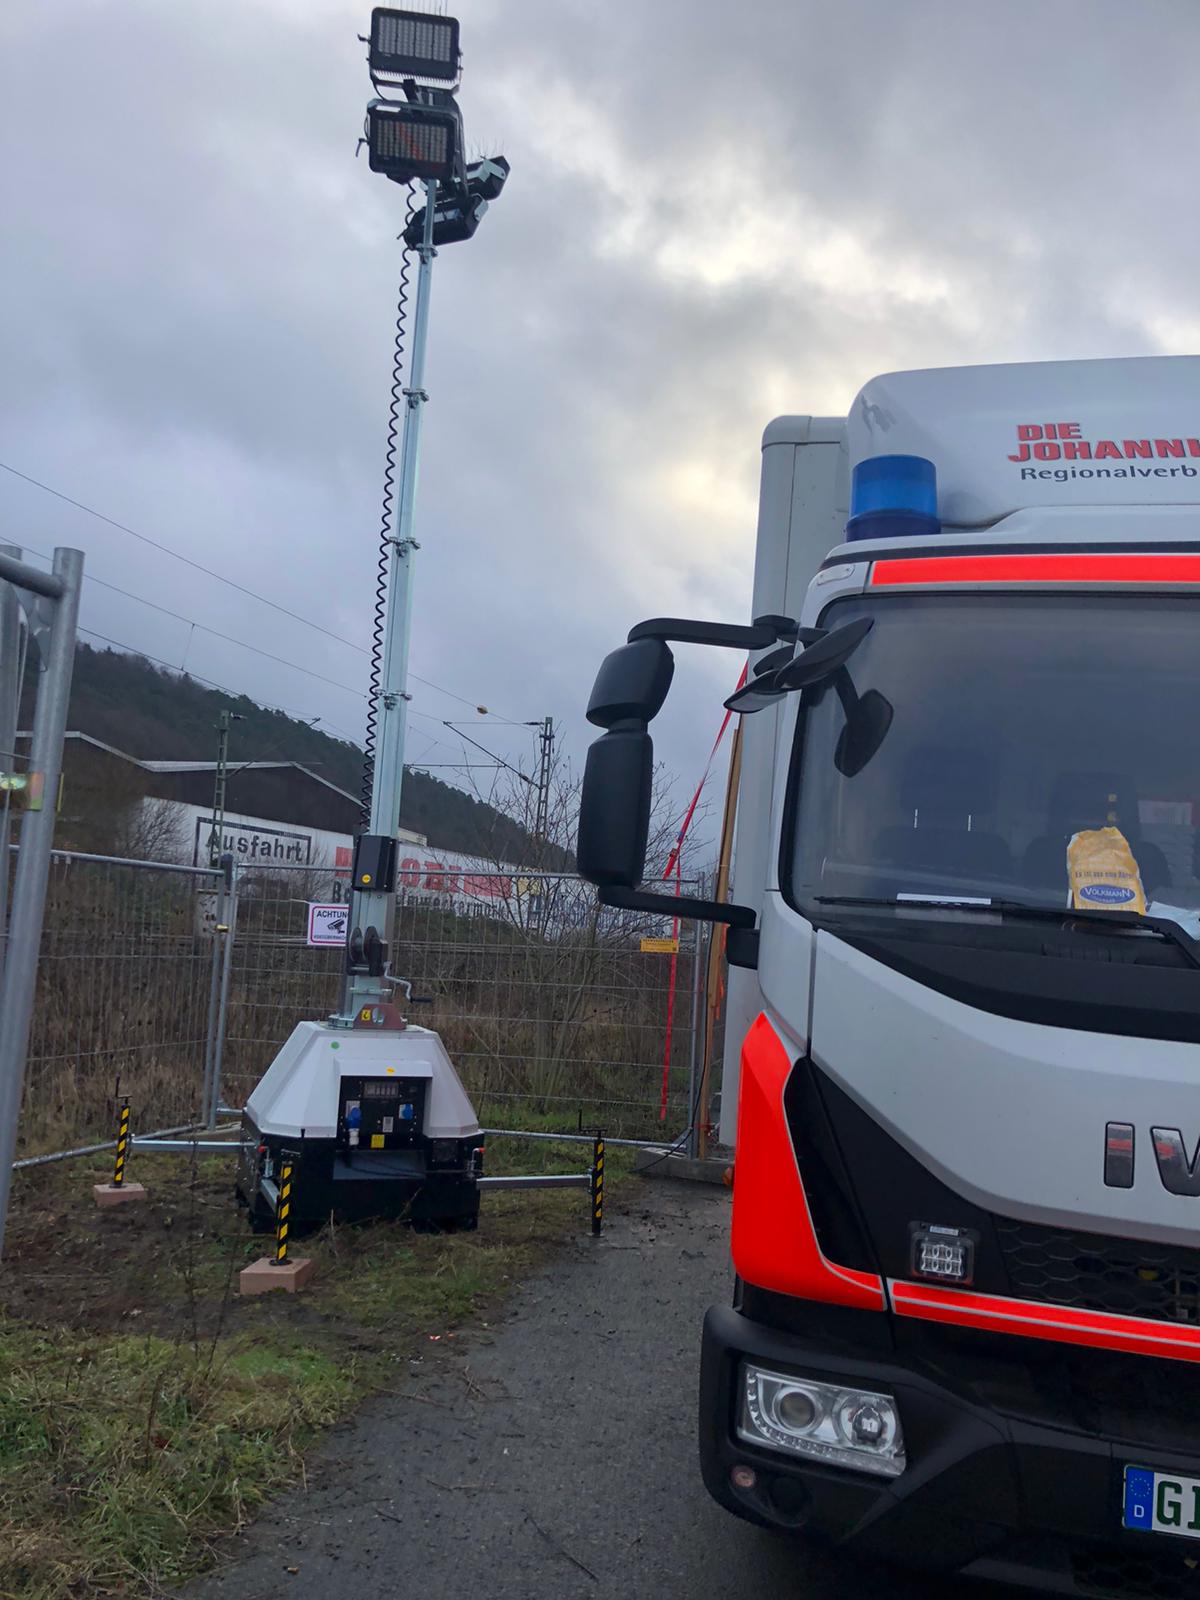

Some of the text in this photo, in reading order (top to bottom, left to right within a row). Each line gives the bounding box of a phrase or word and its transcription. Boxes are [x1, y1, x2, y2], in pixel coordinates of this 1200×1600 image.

[1016, 422, 1082, 442] DIE
[1020, 465, 1198, 483] Regionalverb
[207, 829, 303, 862] Ausfahrt
[316, 910, 348, 919] ACHTUN
[1103, 1121, 1200, 1197] IV
[1133, 1504, 1145, 1518] D
